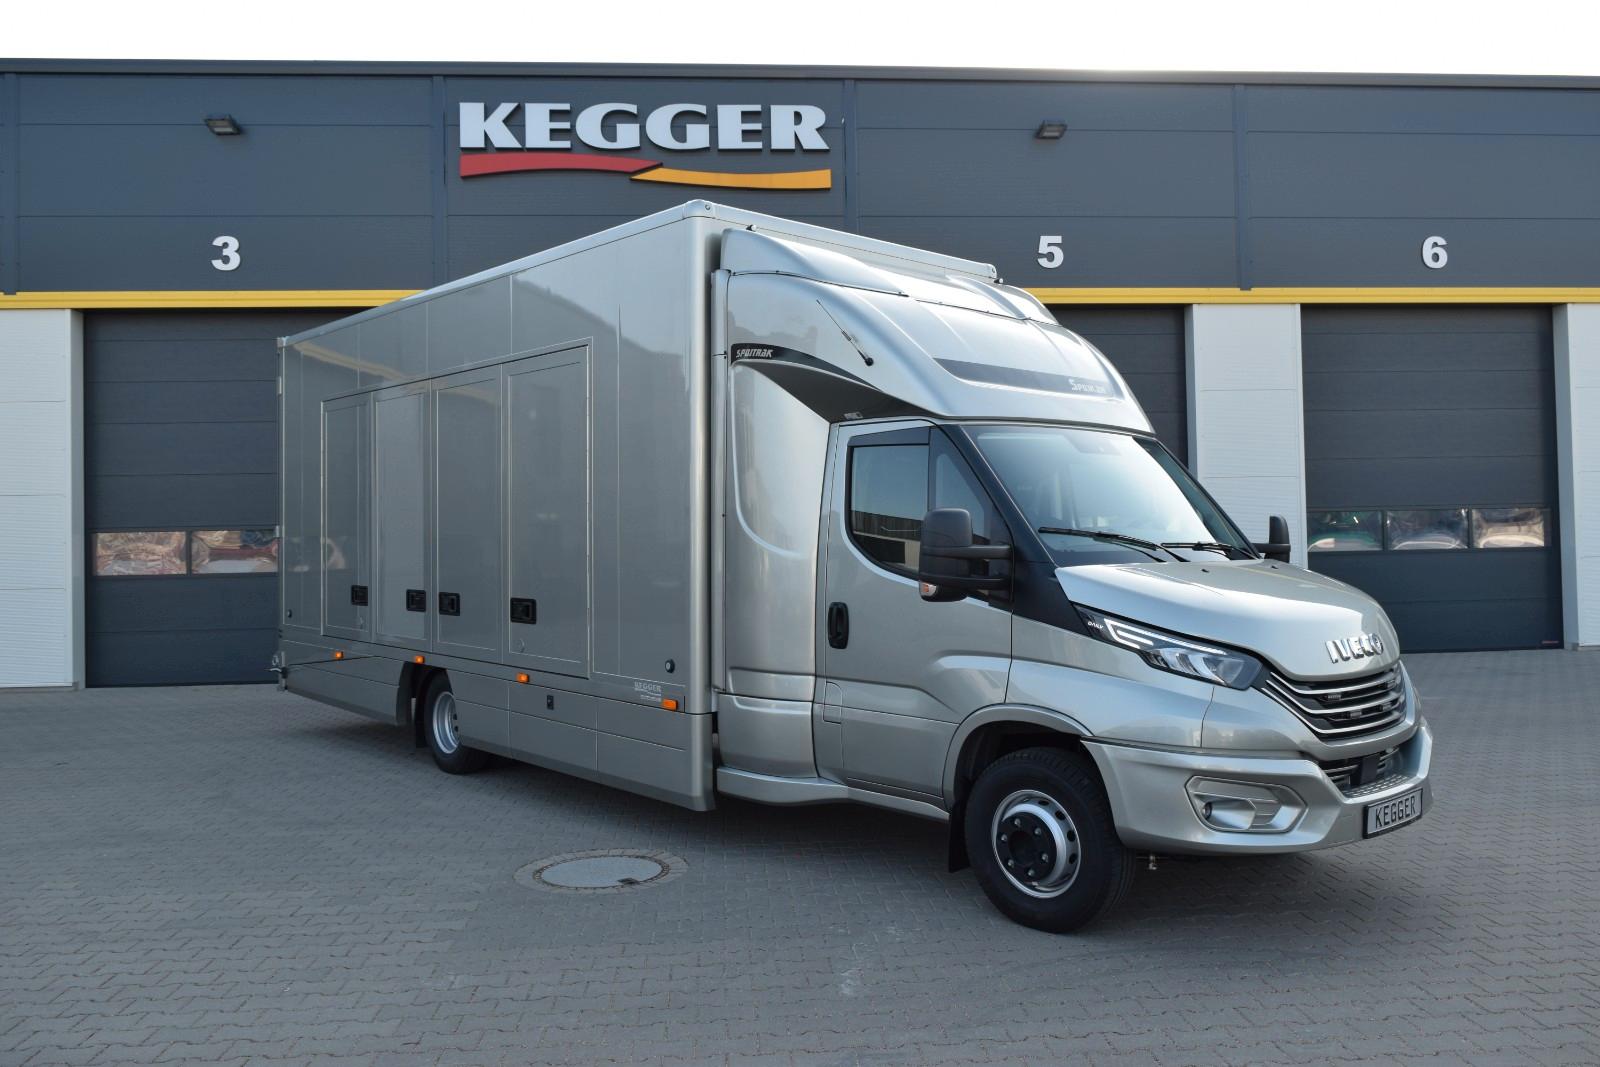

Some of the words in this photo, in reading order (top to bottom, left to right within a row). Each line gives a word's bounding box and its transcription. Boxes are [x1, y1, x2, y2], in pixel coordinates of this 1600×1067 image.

[459, 101, 831, 151] KEGGER
[211, 235, 241, 271] 3
[1037, 235, 1064, 269] 5
[1422, 235, 1448, 269] 6
[1325, 633, 1384, 664] IVECO
[1375, 795, 1416, 829] KEGGER
